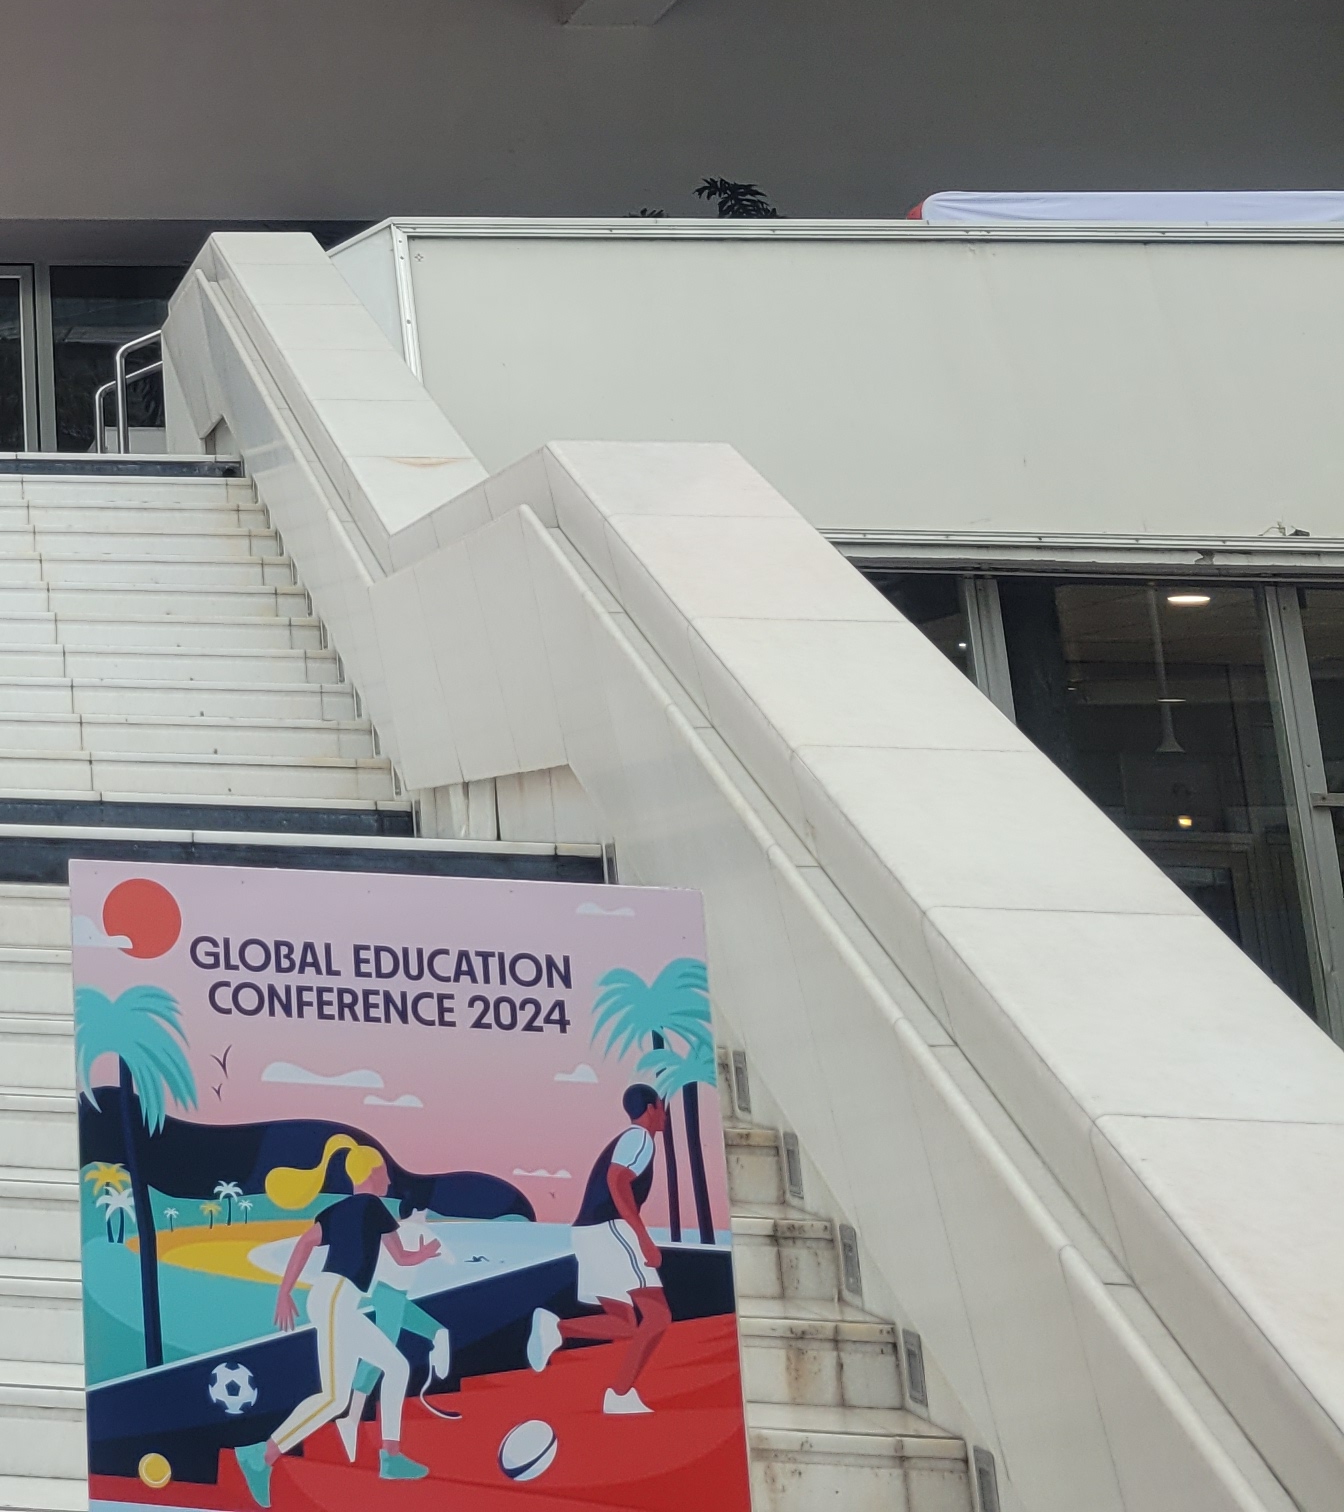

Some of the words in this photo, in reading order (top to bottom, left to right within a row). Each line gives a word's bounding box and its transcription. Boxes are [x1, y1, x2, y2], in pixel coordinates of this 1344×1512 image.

[189, 934, 342, 977] GLOBAL
[352, 943, 573, 990] EDUCATION
[208, 980, 458, 1028] CONFERENCE
[467, 994, 571, 1034] 2024
